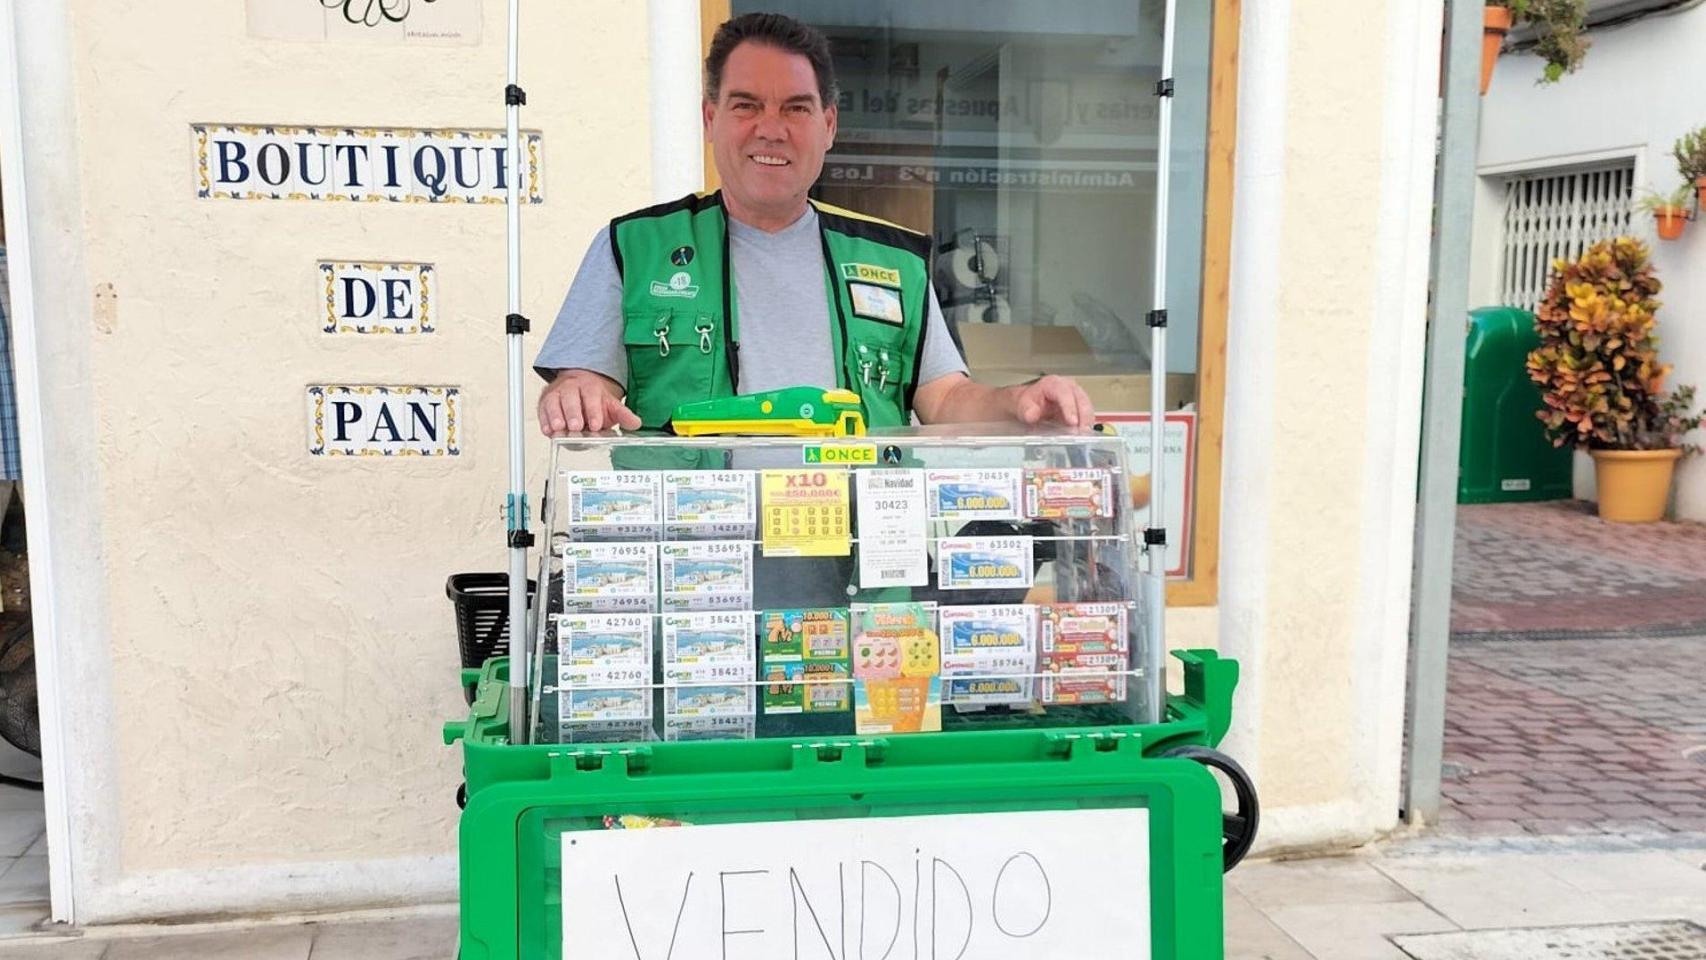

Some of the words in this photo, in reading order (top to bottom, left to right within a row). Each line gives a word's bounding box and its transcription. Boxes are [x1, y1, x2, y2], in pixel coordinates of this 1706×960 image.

[860, 268, 897, 282] ONCE
[340, 277, 414, 319] DE
[331, 401, 441, 441] PAN
[825, 449, 872, 460] ONCE
[616, 475, 651, 484] 93276
[712, 474, 745, 483] 14287
[785, 472, 827, 487] x10
[884, 478, 914, 488] Navidad
[875, 500, 908, 510] 30423
[611, 546, 646, 554] 76954
[606, 618, 641, 626] 42760
[710, 615, 744, 624] 38421
[607, 671, 642, 680] 42760
[711, 668, 745, 676] 38421
